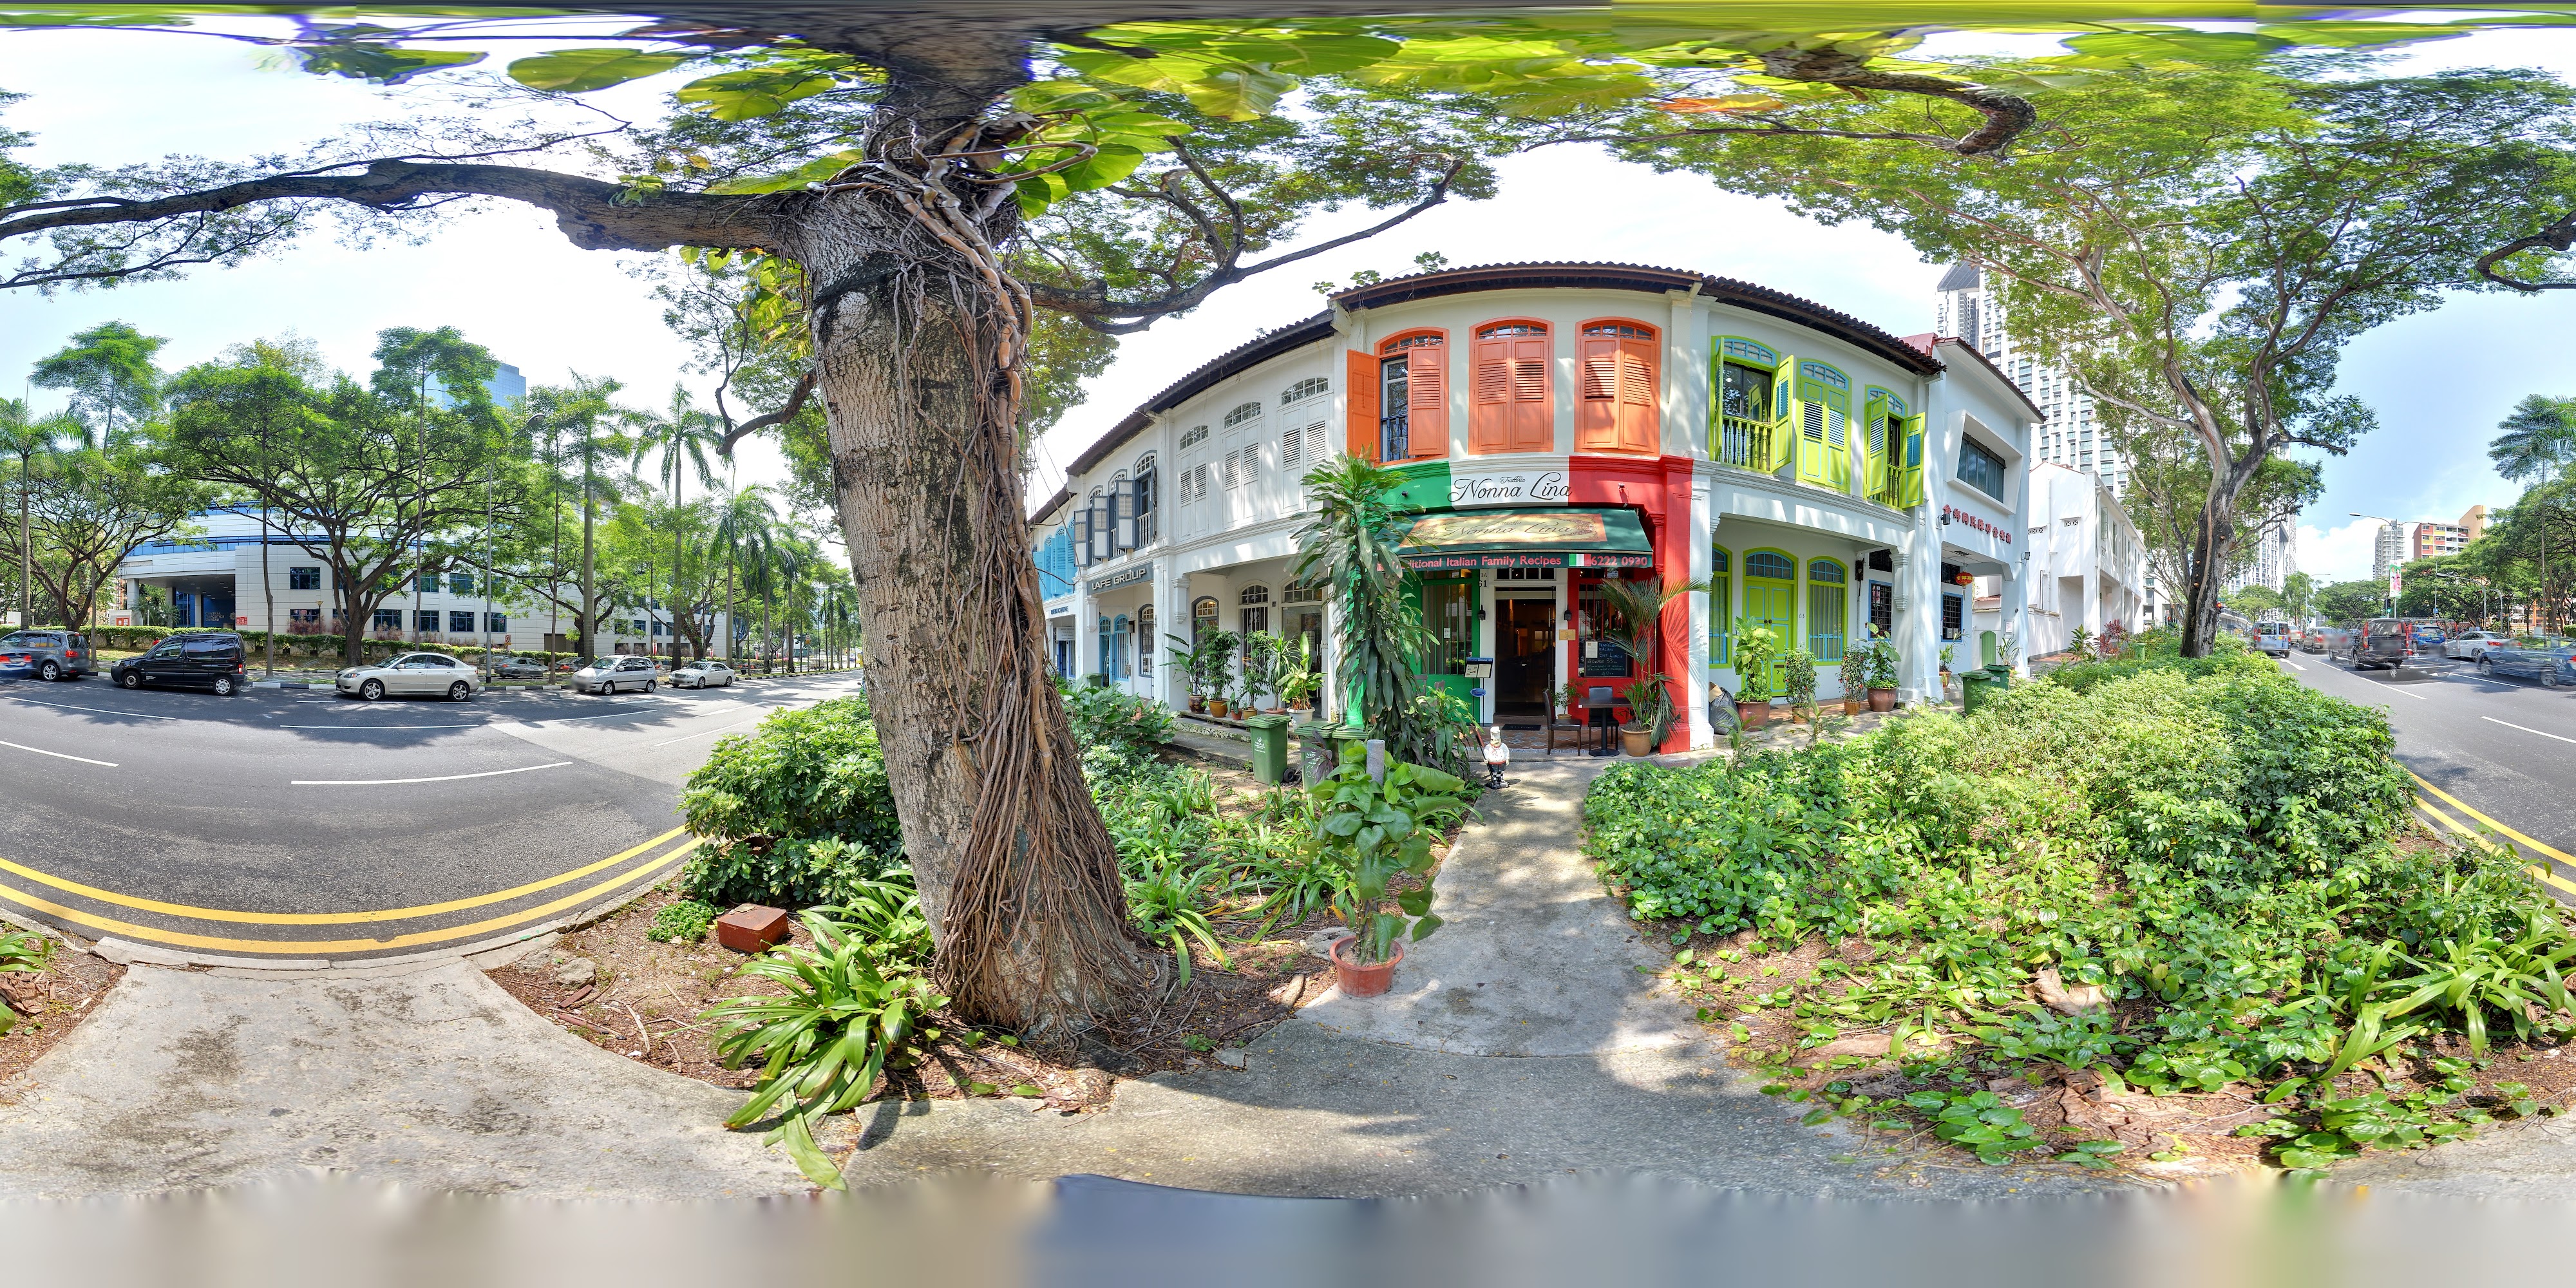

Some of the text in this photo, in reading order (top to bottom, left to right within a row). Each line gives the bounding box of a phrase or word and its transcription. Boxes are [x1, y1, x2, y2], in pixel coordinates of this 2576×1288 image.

[1446, 471, 1573, 502] Nonna Lina
[1500, 475, 1526, 484] Trattoria
[1434, 521, 1572, 537] Nonna Lina
[1446, 557, 1477, 567] Italian
[1481, 556, 1516, 567] Family
[1520, 555, 1561, 567] Recipes
[1591, 556, 1617, 567] 6222
[1621, 556, 1648, 567] 0930
[1092, 568, 1147, 591] LAFE GROUP
